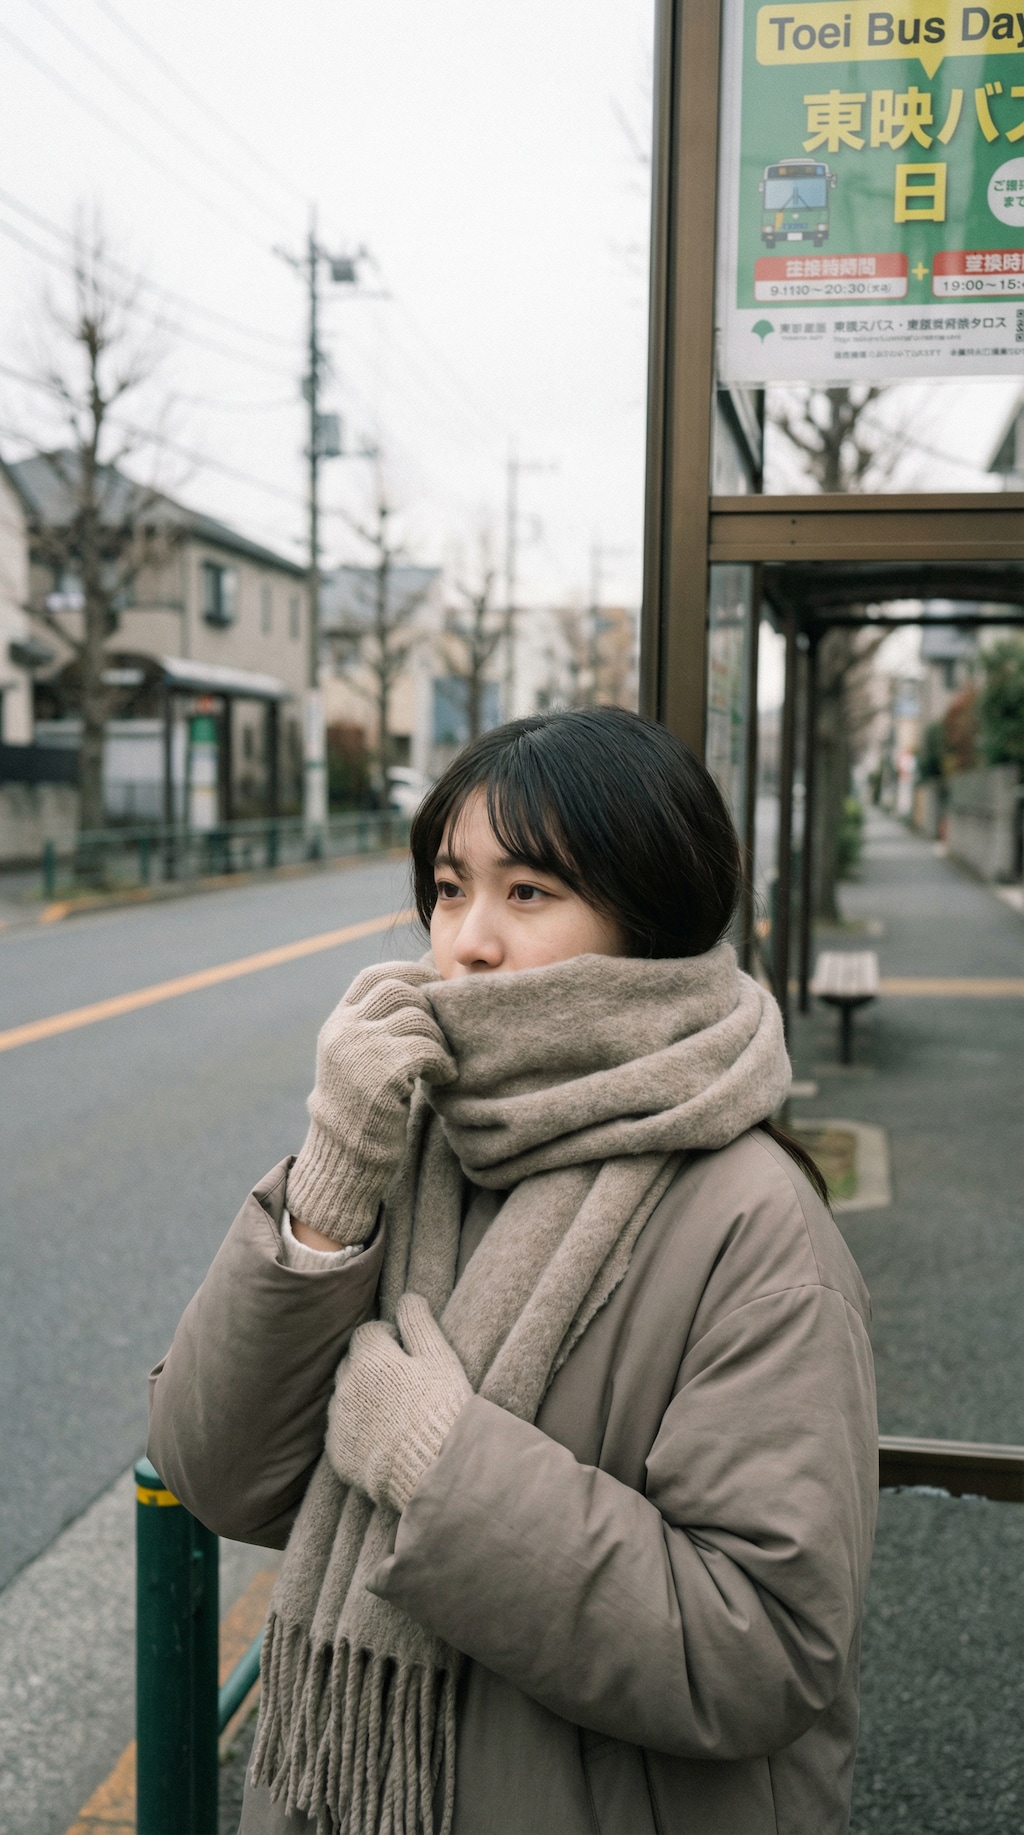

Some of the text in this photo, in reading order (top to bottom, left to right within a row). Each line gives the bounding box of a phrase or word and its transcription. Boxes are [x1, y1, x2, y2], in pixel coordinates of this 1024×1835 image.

[769, 14, 852, 51] Toei
[868, 12, 946, 46] Bus
[894, 162, 947, 224] 日
